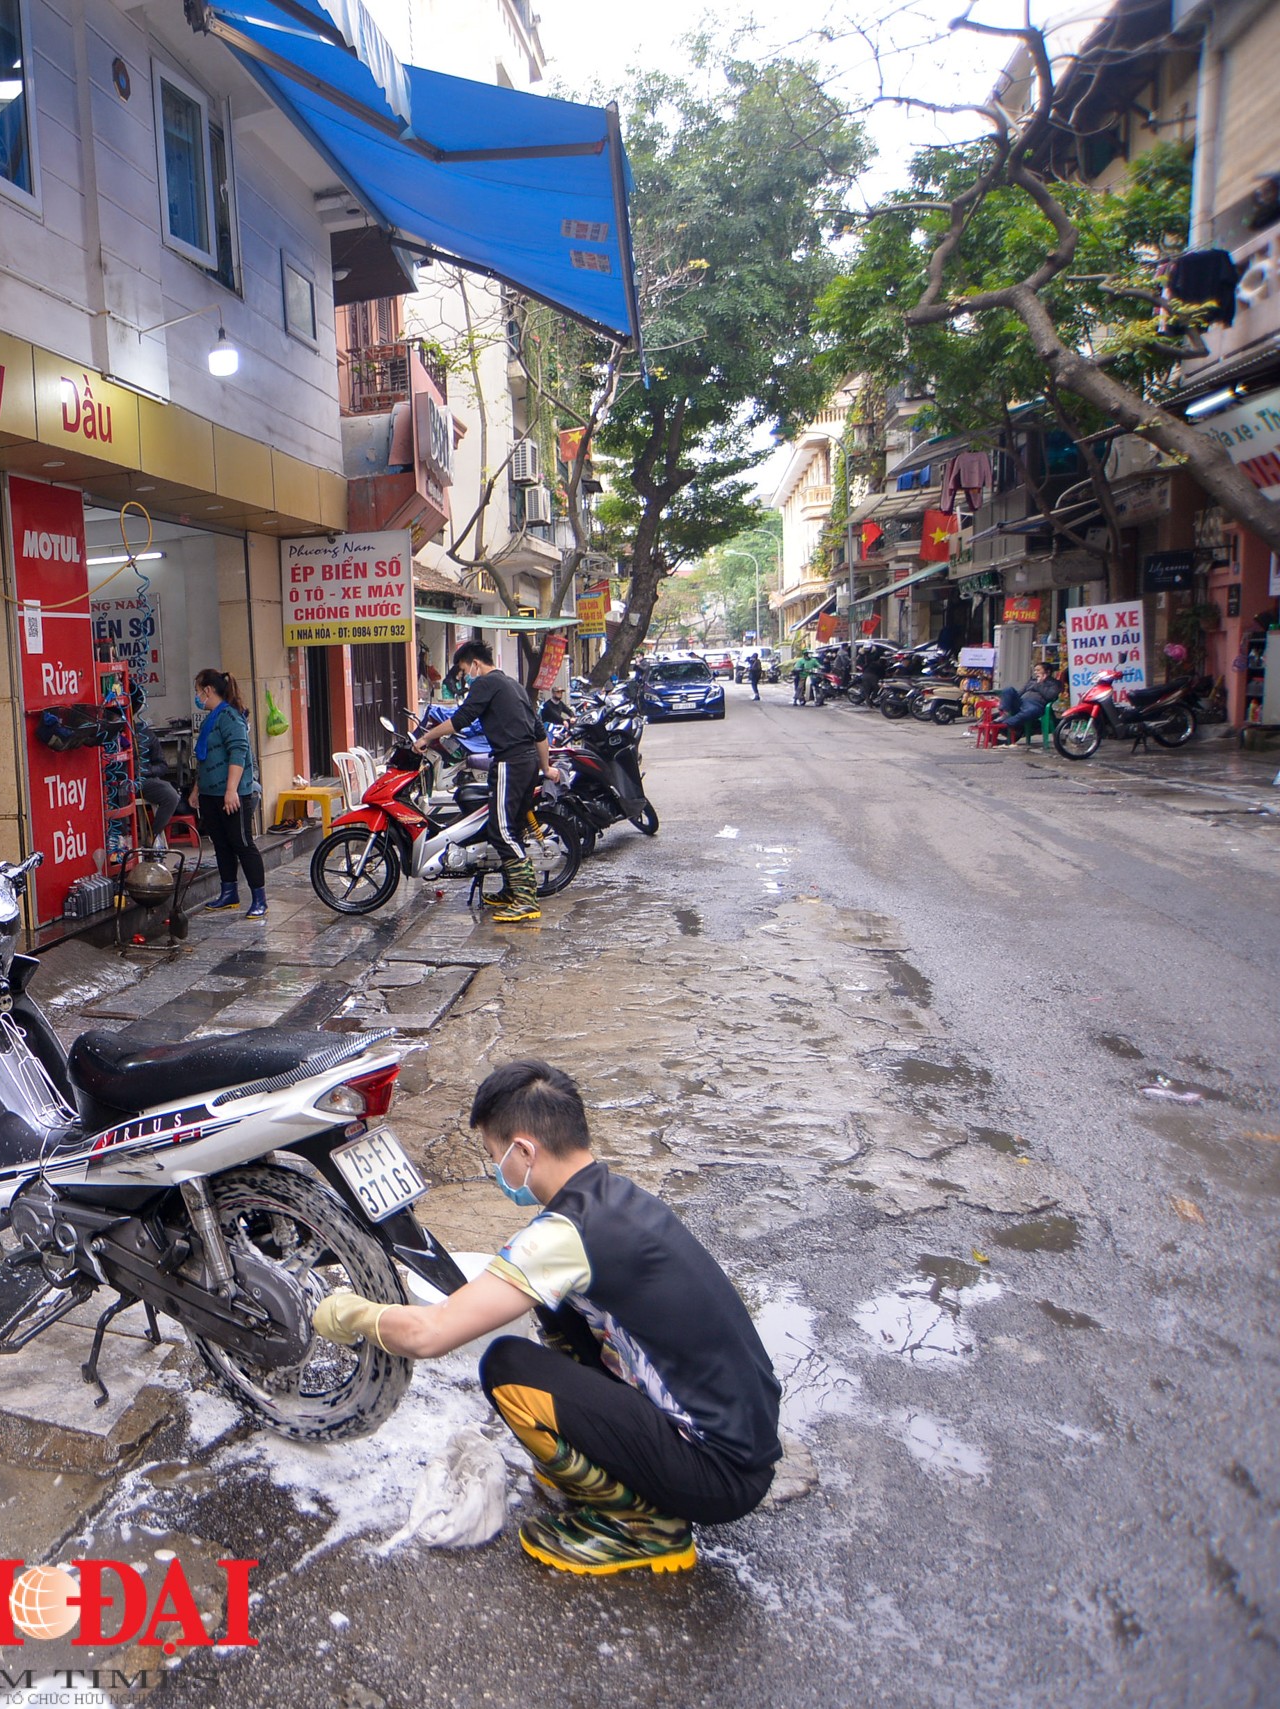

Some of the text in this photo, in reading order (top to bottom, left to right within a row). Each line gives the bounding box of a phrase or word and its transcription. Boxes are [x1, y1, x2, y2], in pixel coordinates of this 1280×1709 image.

[60, 373, 114, 444] Dầu
[23, 530, 80, 563] MOTUL
[343, 541, 376, 554] Nam
[291, 554, 402, 583] ÉP BIỂN SỐ
[289, 587, 299, 603] Ô
[305, 586, 324, 602] TÔ
[341, 586, 362, 600] XE
[368, 582, 405, 598] MÁY
[294, 600, 402, 621] CHỐNG NƯỚC
[1071, 608, 1139, 633] RỬA XE
[91, 612, 123, 639] IỂN
[290, 630, 295, 640] 1
[352, 626, 372, 637] 0984
[373, 625, 388, 636] 977
[390, 624, 406, 636] 932
[1071, 635, 1106, 650] THAY
[1074, 652, 1113, 666] BƠM
[41, 661, 79, 696] Rửa
[43, 774, 87, 811] Thay
[53, 820, 87, 864] Dầu
[102, 1113, 182, 1147] SIRIUS
[343, 1134, 397, 1179] 75-F1
[359, 1161, 421, 1214] 371.61
